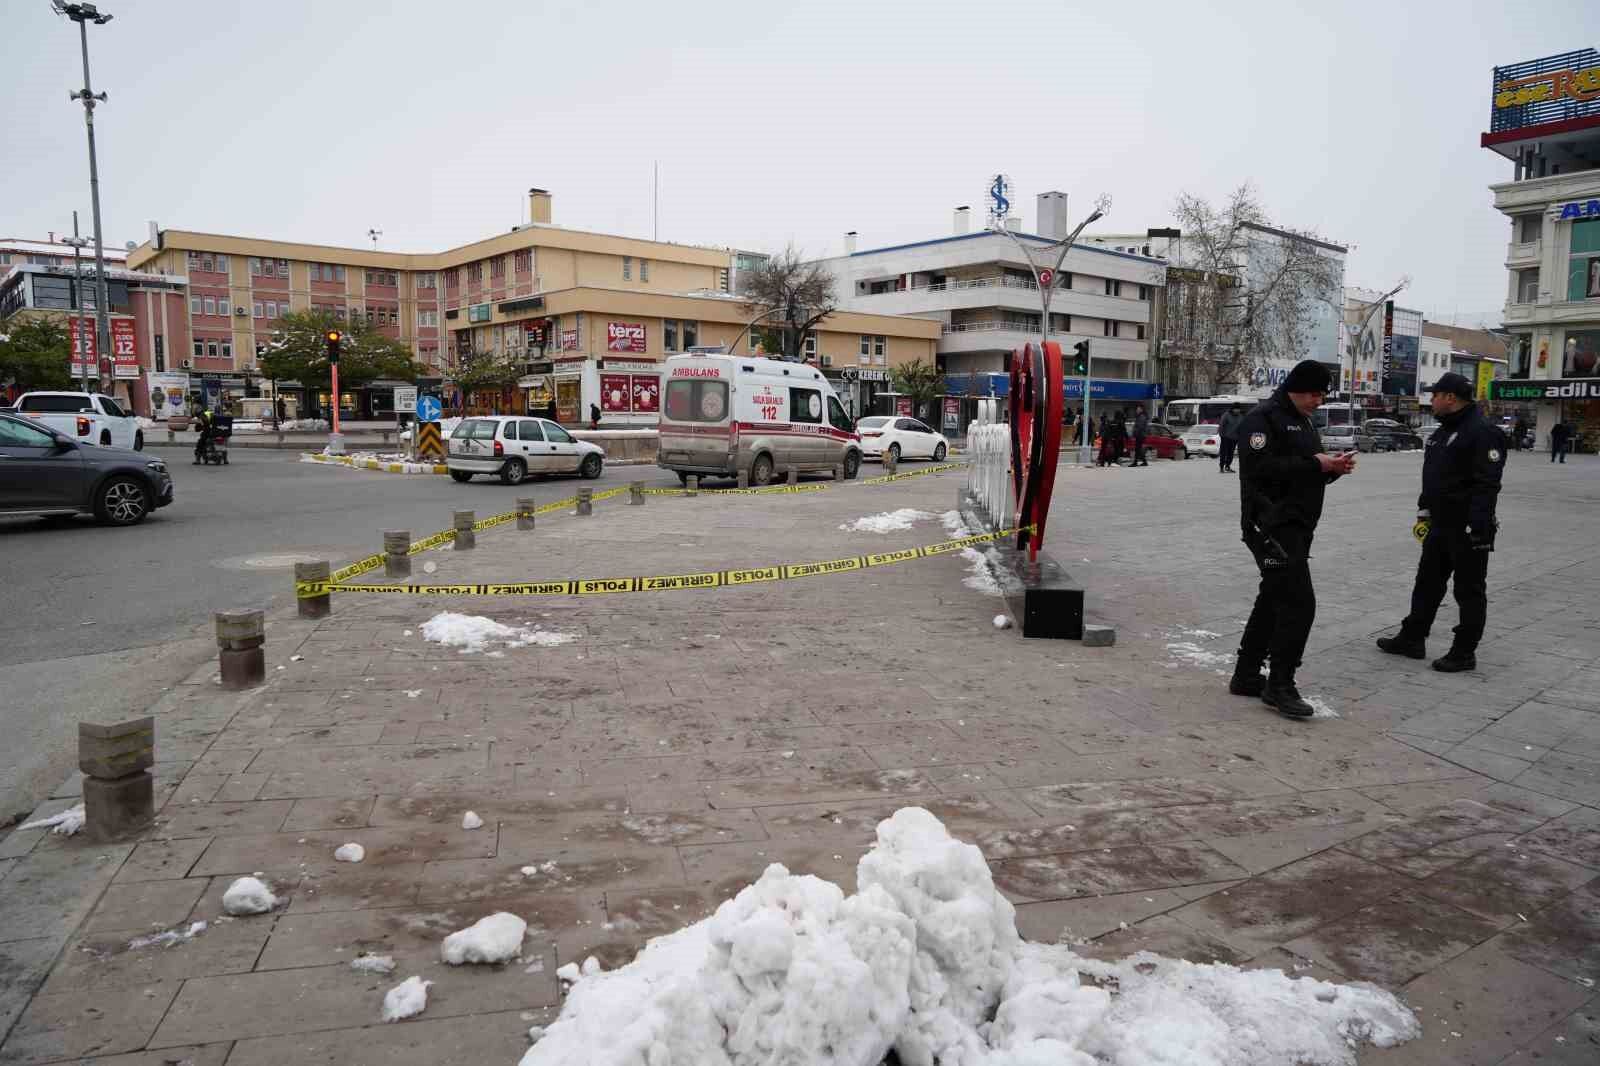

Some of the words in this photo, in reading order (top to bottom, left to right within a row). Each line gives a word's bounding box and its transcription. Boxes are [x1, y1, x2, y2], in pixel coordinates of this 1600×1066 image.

[608, 323, 645, 339] terzi
[117, 341, 134, 355] 12
[672, 368, 720, 377] AMBULANS
[1545, 382, 1587, 397] adil
[762, 406, 777, 420] 112
[873, 551, 913, 563] POLİS
[793, 559, 855, 576] GİRİLMEZ
[648, 575, 714, 589] GİRİLMEZ
[734, 569, 774, 582] POLİS
[493, 584, 563, 594] GİRİLMEZ
[585, 580, 627, 592] POLİS
